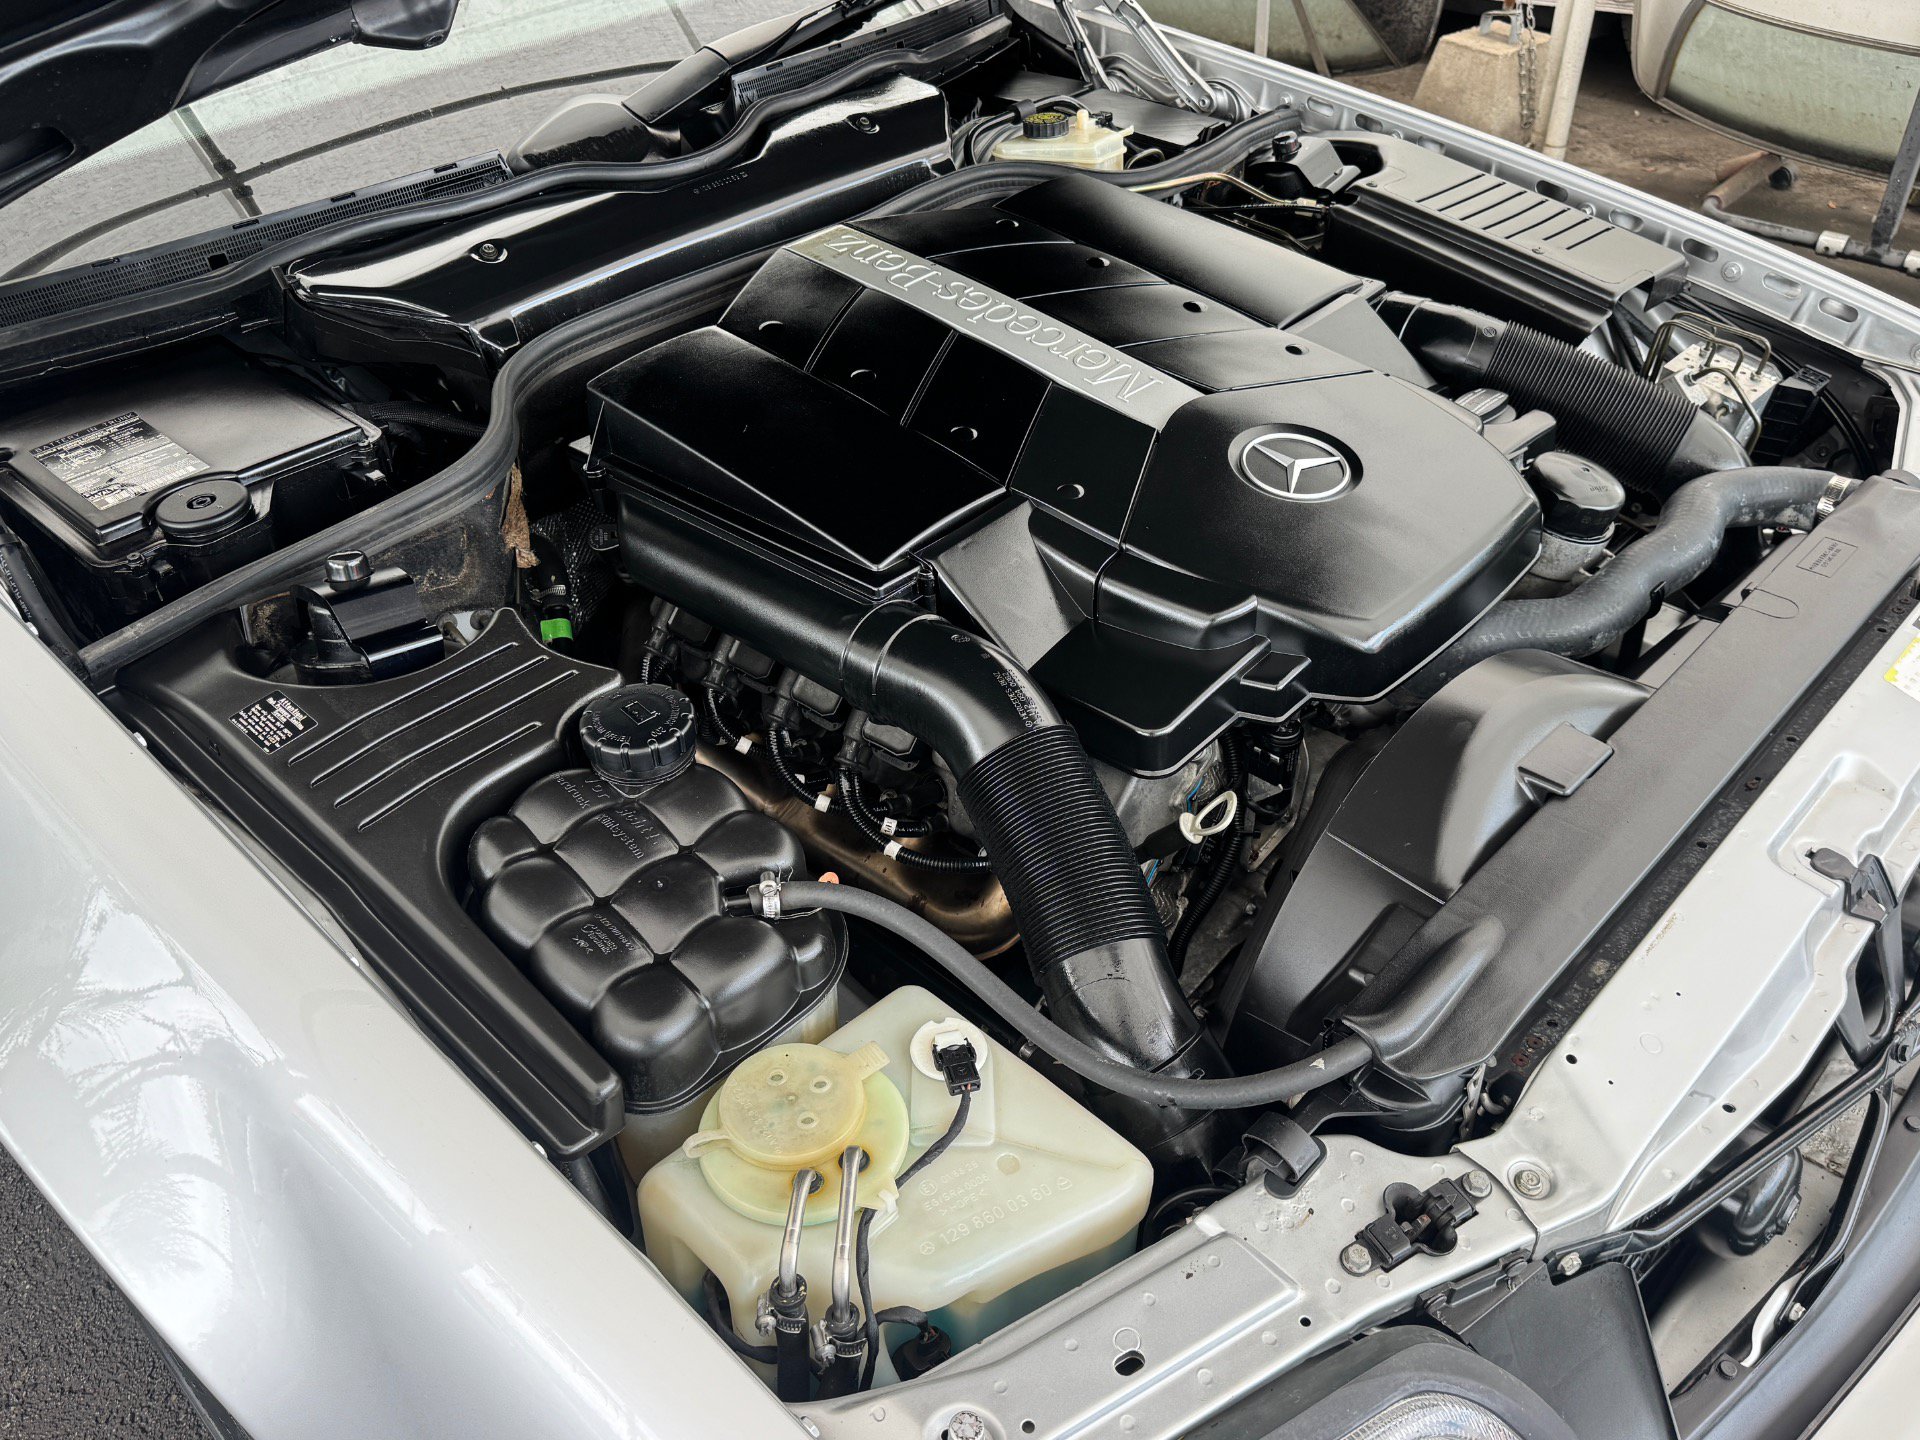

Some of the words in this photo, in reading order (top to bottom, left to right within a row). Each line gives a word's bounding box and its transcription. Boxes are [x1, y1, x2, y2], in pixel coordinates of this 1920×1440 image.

[823, 233, 1164, 403] Mercedes-Benz
[35, 432, 79, 452] BATTERY
[86, 424, 98, 433] IN
[103, 413, 134, 427] TRUNK
[940, 1223, 970, 1245] 129
[972, 1205, 1005, 1229] 860
[1006, 1195, 1029, 1213] 03
[1030, 1182, 1052, 1202] 60
